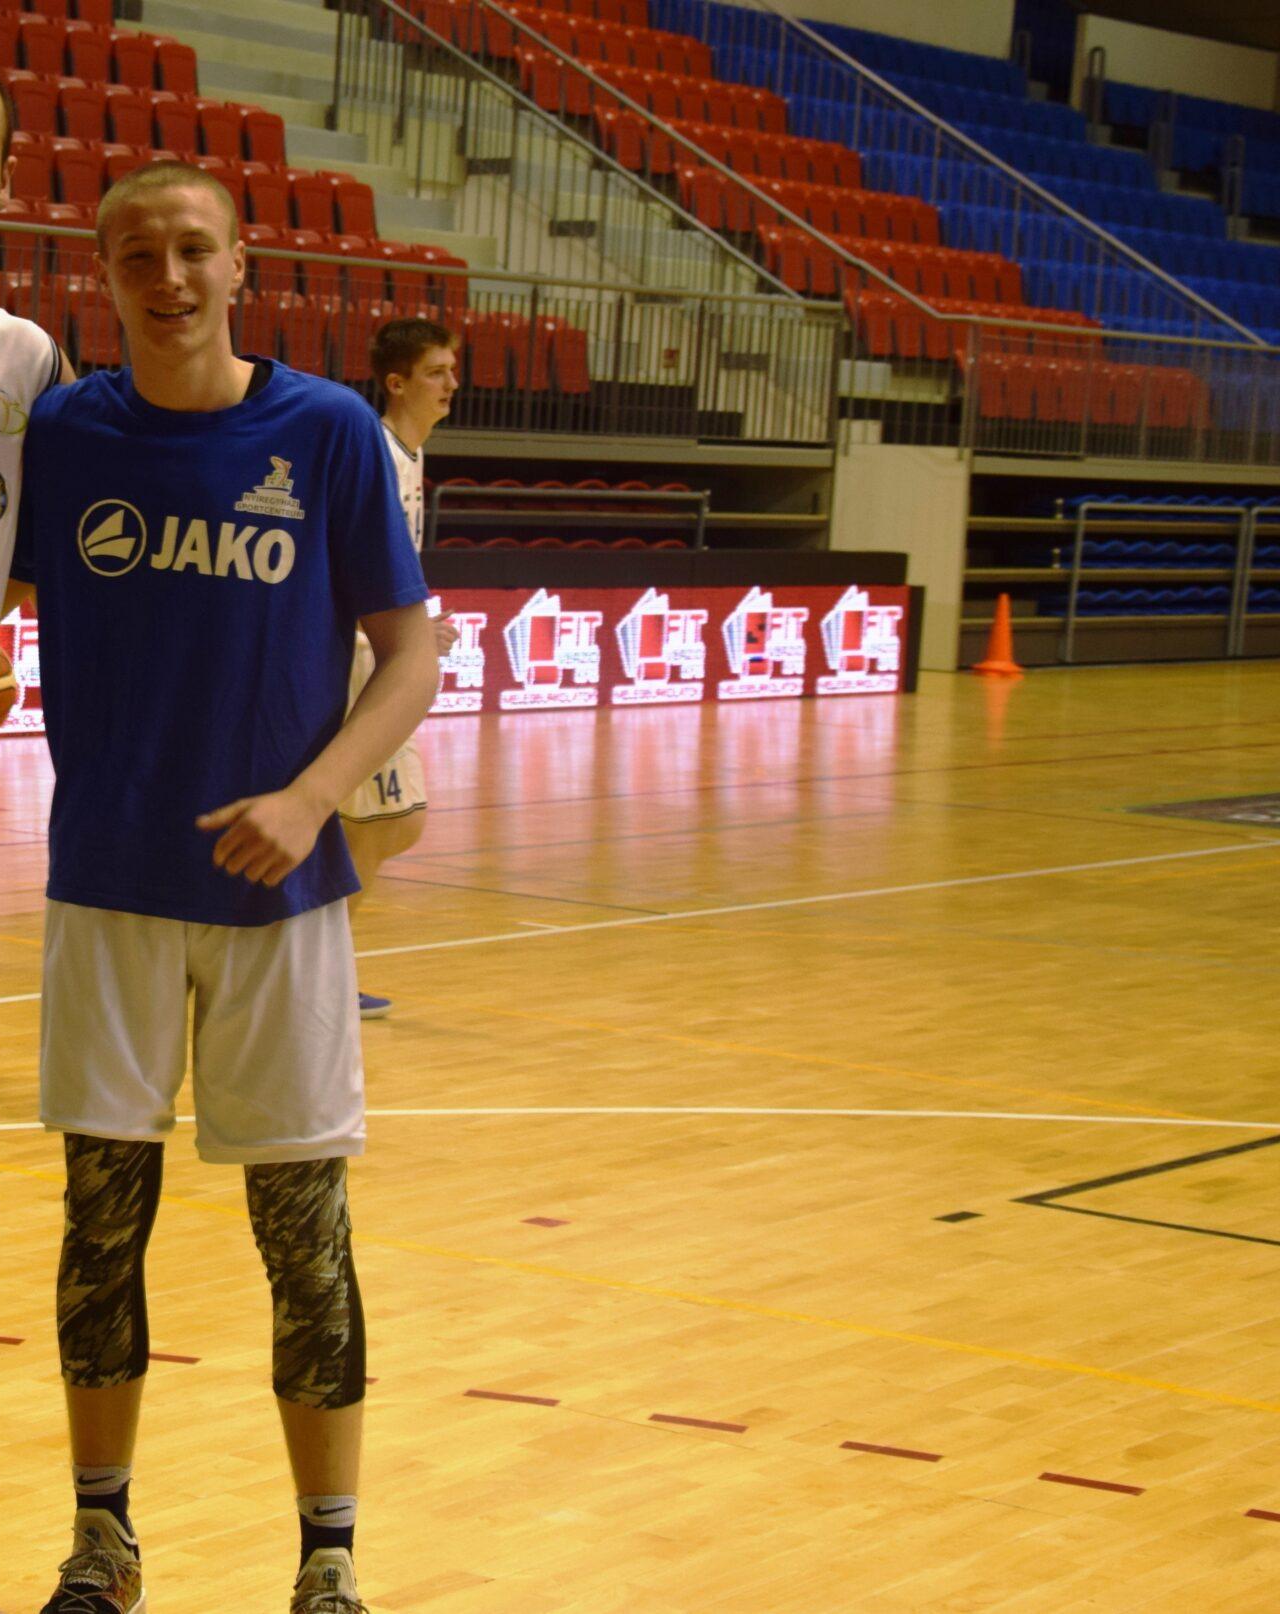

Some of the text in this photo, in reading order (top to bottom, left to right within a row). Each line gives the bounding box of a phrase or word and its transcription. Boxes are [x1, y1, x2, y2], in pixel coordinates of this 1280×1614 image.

[150, 515, 296, 585] JAKO
[557, 616, 600, 647] FIT
[373, 769, 402, 805] 14
